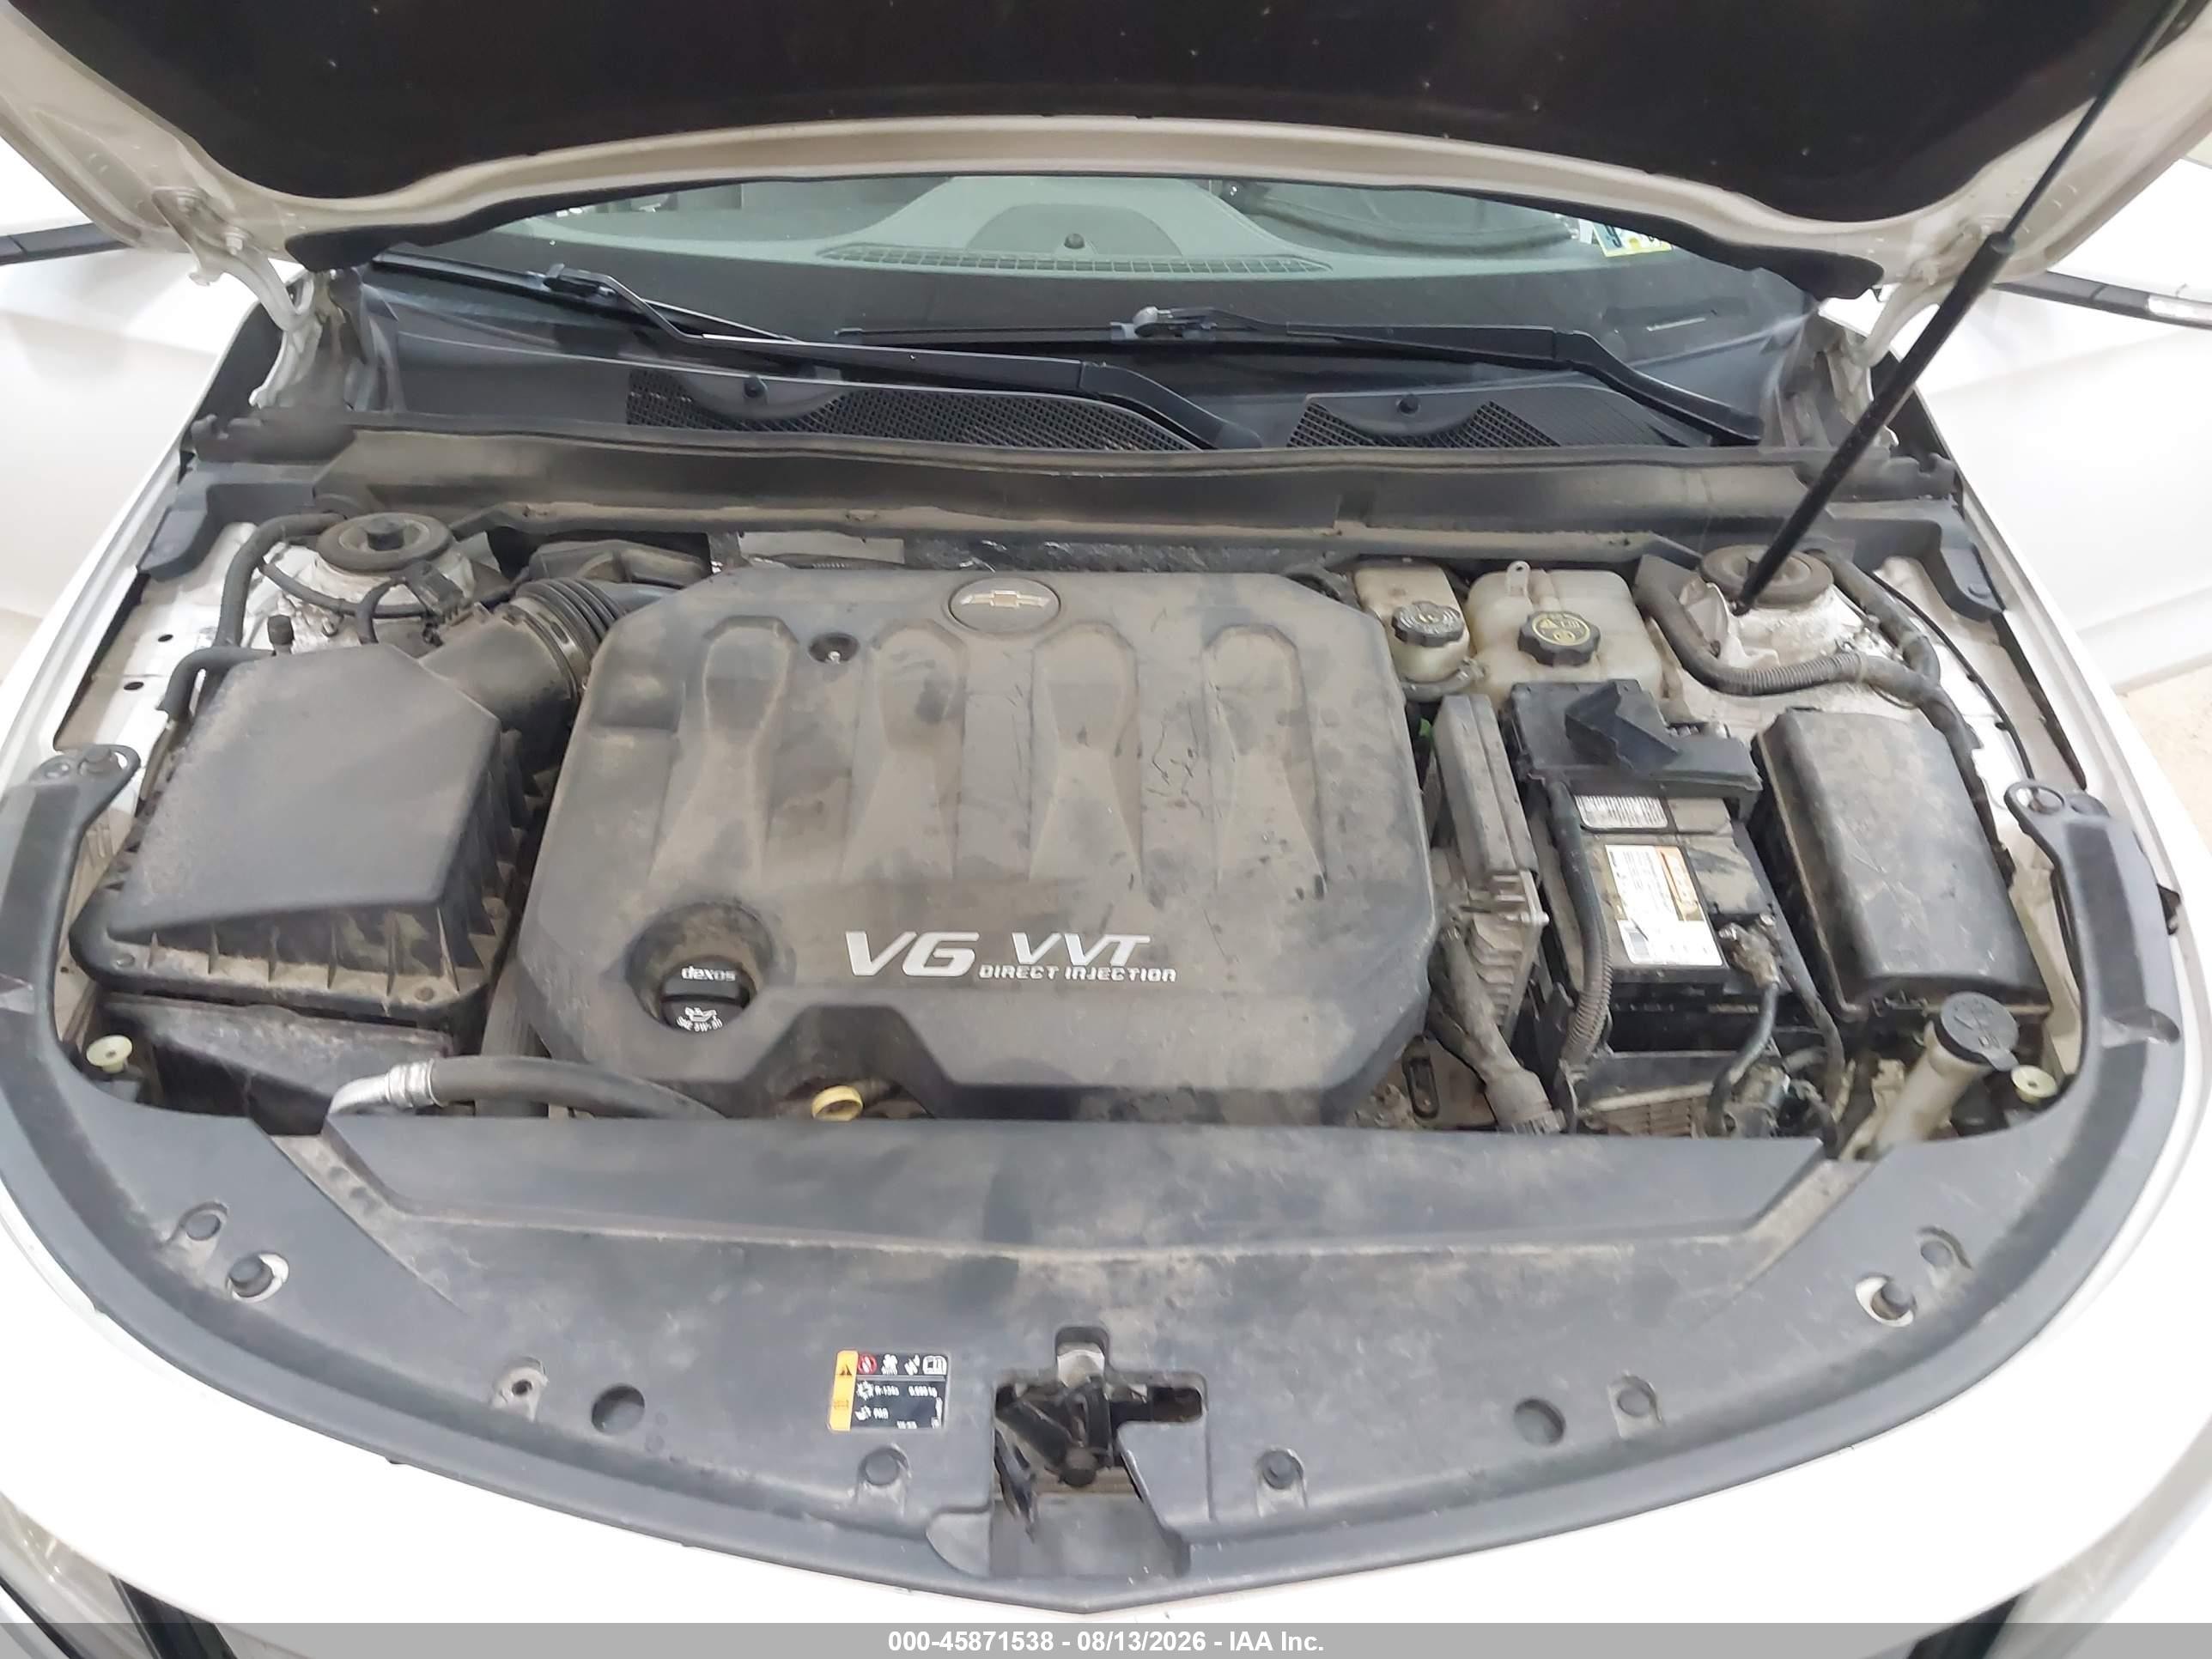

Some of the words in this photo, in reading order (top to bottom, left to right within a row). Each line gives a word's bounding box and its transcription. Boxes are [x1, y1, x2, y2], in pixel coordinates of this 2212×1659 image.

[845, 931, 980, 977] V6
[1012, 932, 1152, 967] VVT
[979, 964, 1060, 980] DIRECT
[1064, 966, 1177, 983] INJECTION
